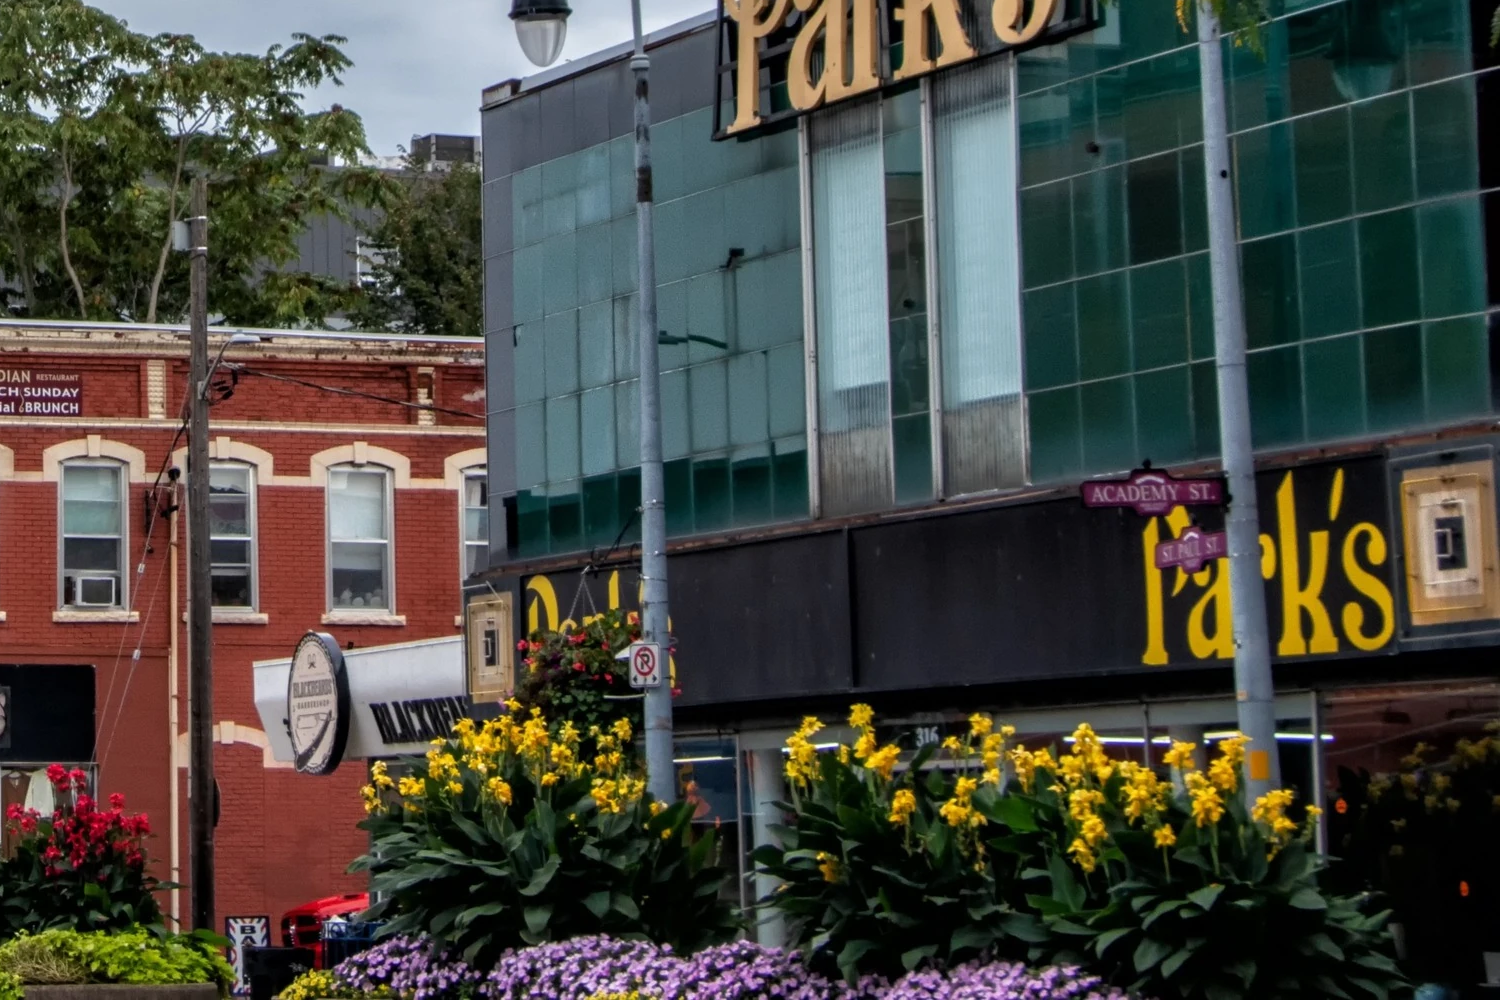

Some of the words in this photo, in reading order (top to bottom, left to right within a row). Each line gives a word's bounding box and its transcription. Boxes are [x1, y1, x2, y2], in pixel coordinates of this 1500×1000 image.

[36, 373, 79, 382] RESTAURANT
[24, 387, 79, 398] SUNDAY
[25, 402, 79, 414] BRUNCH
[1092, 482, 1179, 502] ACADEMY
[1190, 483, 1216, 500] ST.
[1162, 545, 1177, 562] ST.
[1178, 540, 1200, 559] PAUL
[1142, 468, 1394, 665] Pak's
[293, 678, 333, 698] BLACKBEARDS
[916, 726, 939, 748] 316
